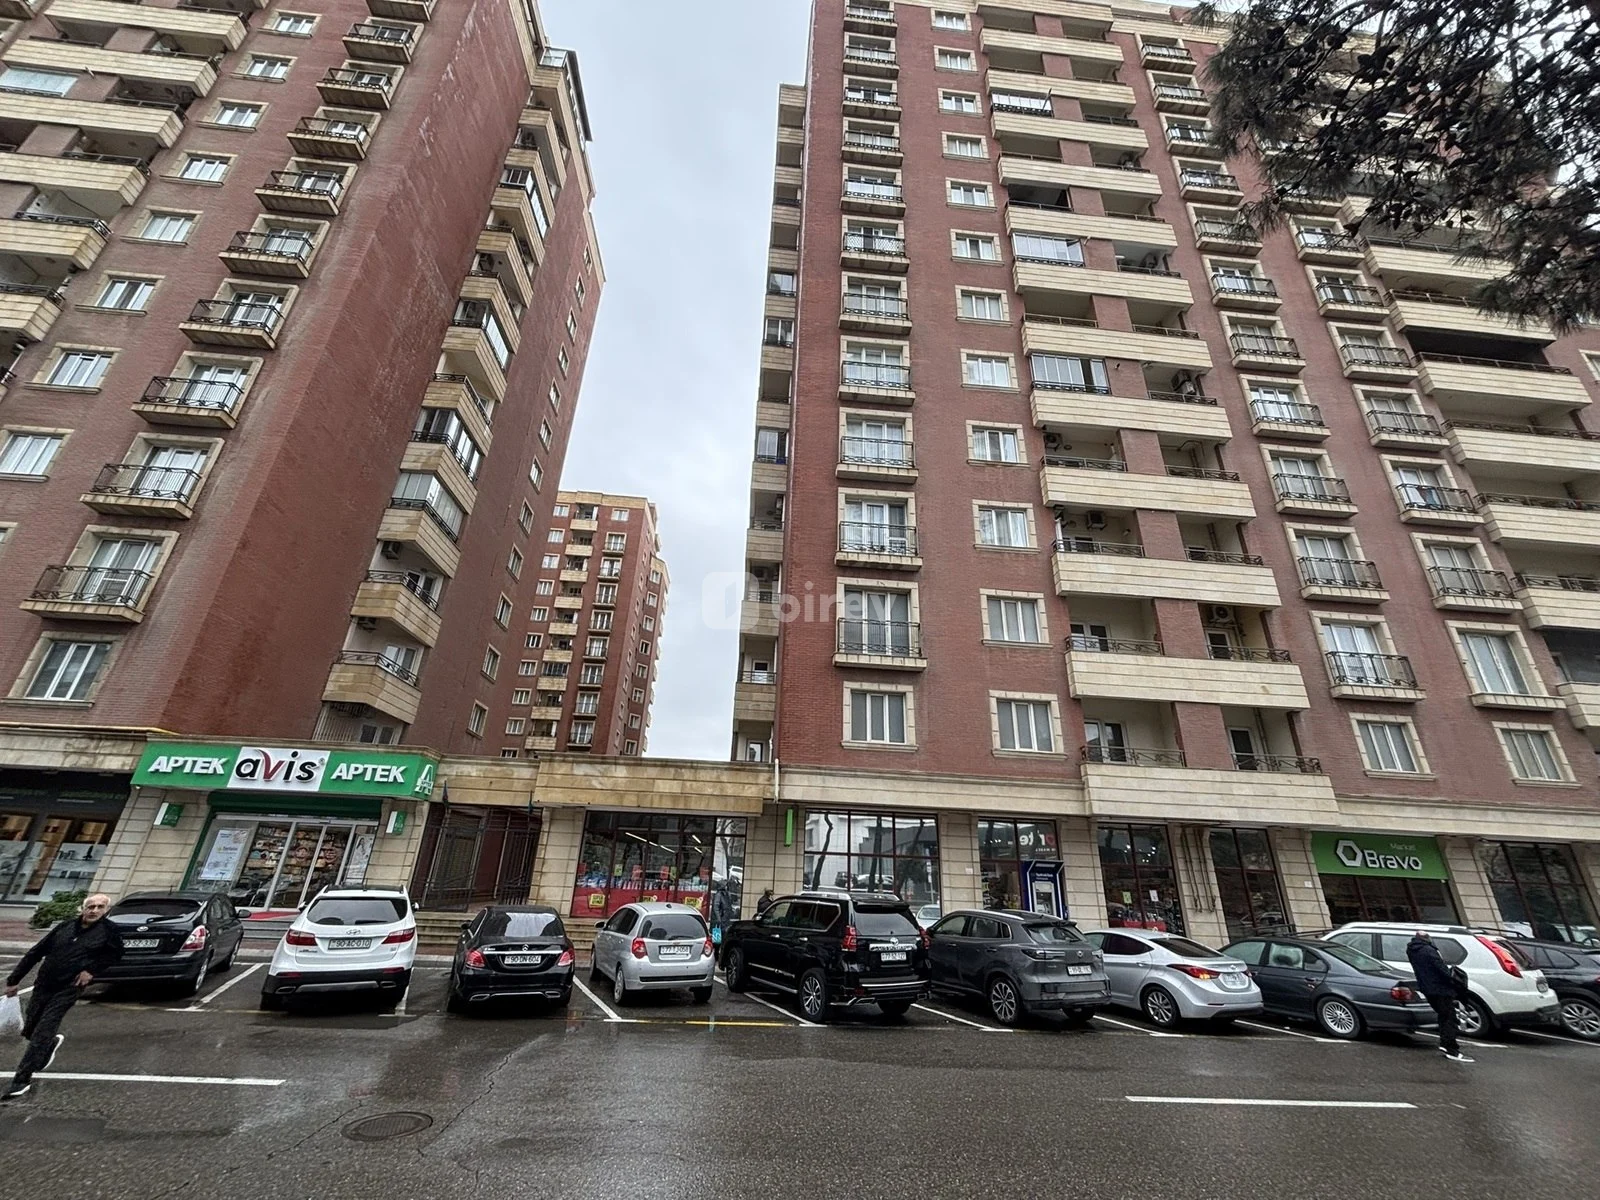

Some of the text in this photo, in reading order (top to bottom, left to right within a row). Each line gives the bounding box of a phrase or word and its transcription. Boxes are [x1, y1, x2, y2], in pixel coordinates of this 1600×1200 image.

[147, 755, 229, 776] APTEK
[235, 749, 318, 782] avis
[330, 762, 407, 784] APTEK
[1364, 849, 1423, 872] Bravo
